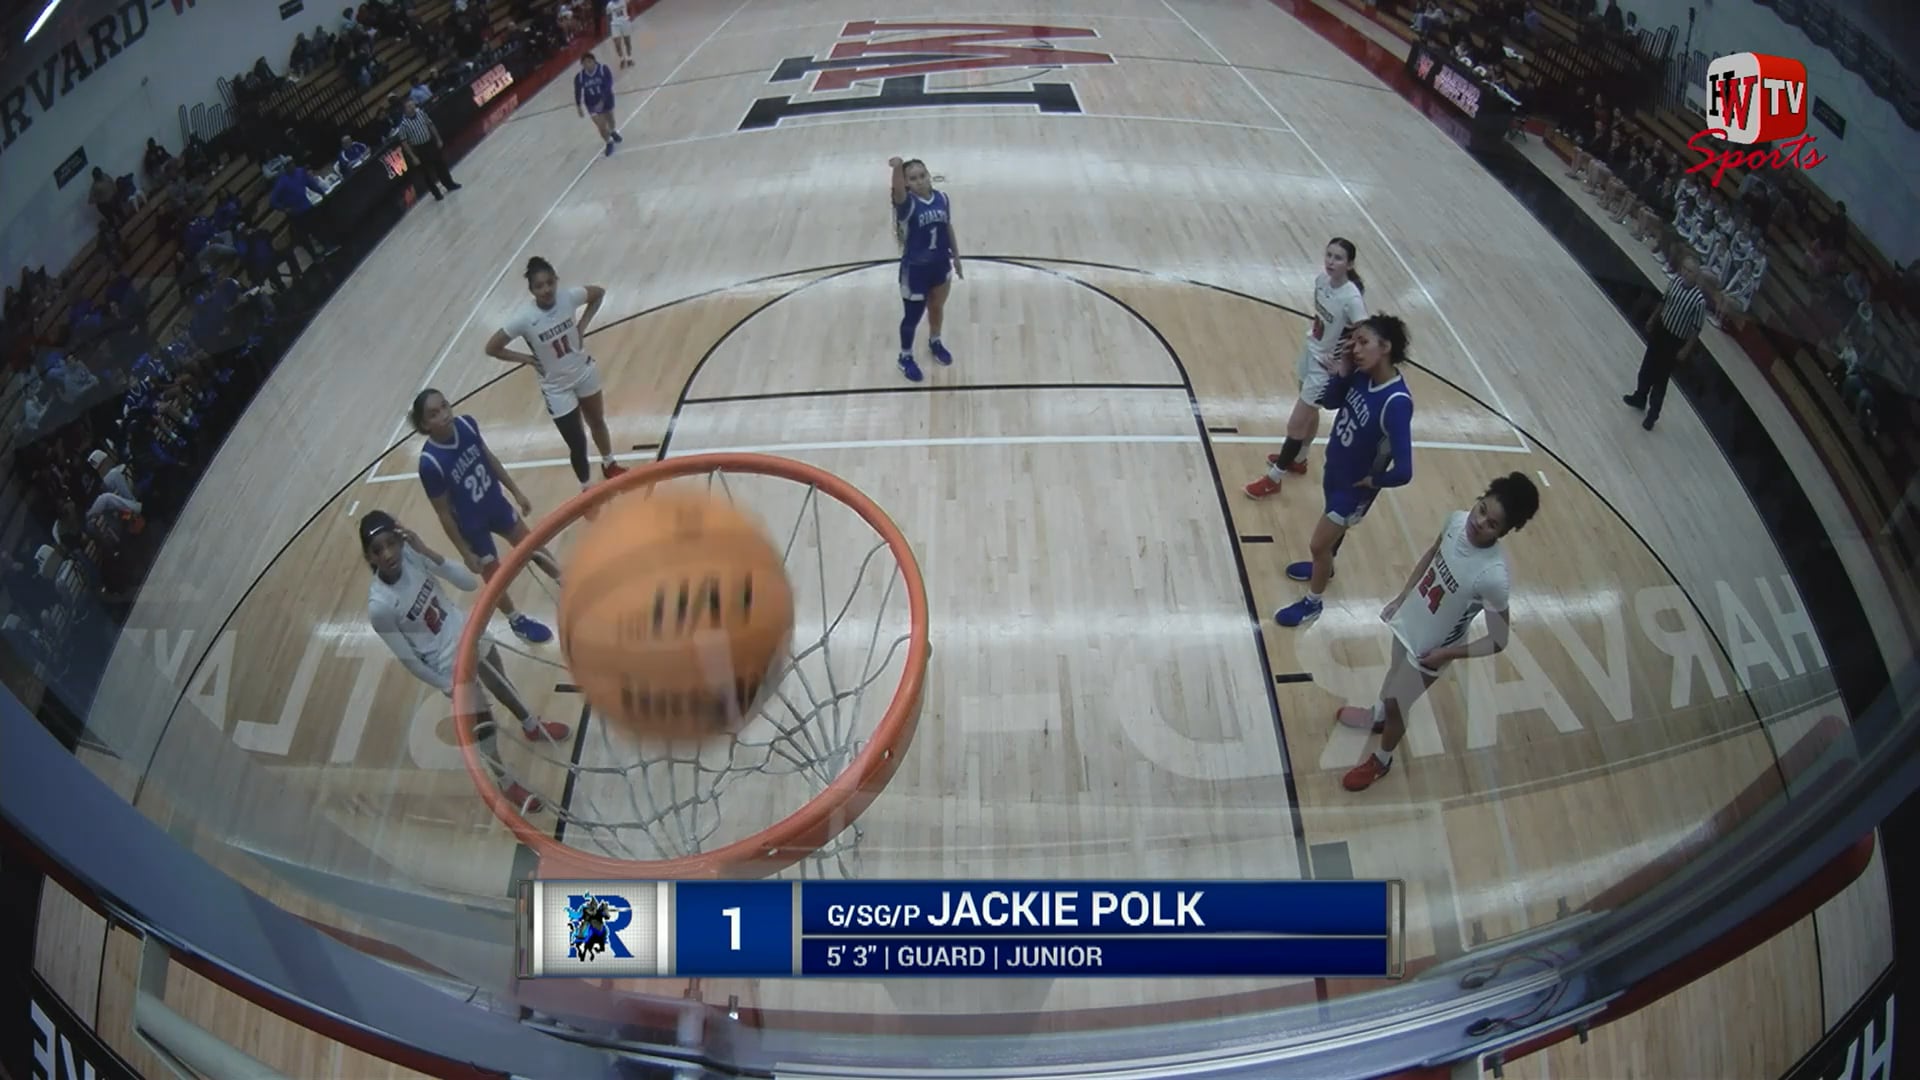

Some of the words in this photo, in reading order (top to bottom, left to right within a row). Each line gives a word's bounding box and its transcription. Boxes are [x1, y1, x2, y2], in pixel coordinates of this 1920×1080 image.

[928, 226, 938, 250] 1
[552, 334, 573, 359] 11
[1335, 407, 1358, 448] 25
[1345, 387, 1371, 428] RIALTO
[451, 444, 482, 485] RIALTO
[464, 463, 492, 503] 22
[1418, 566, 1446, 615] 24
